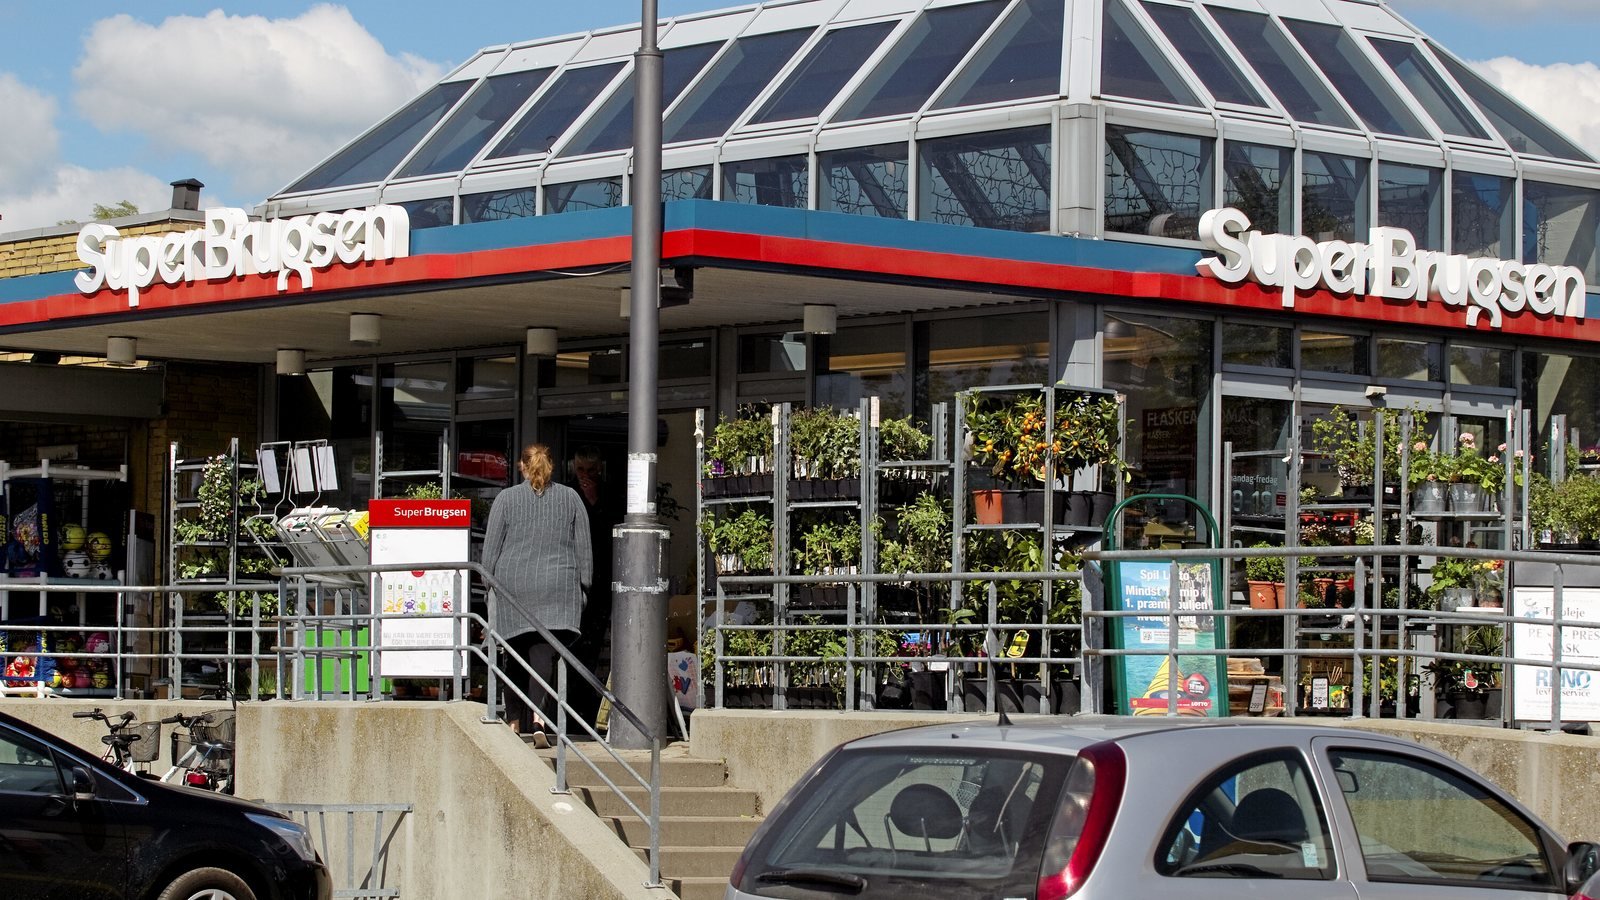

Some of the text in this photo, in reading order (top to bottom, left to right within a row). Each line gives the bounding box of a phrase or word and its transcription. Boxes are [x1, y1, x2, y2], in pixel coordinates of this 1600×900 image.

[74, 204, 409, 307] SuperBrugsen
[1195, 207, 1586, 328] SuperBrugsen
[394, 507, 467, 519] SuperBrugsen
[1140, 570, 1159, 581] Spil
[1125, 585, 1161, 596] Mindst
[1125, 599, 1134, 608] 1.
